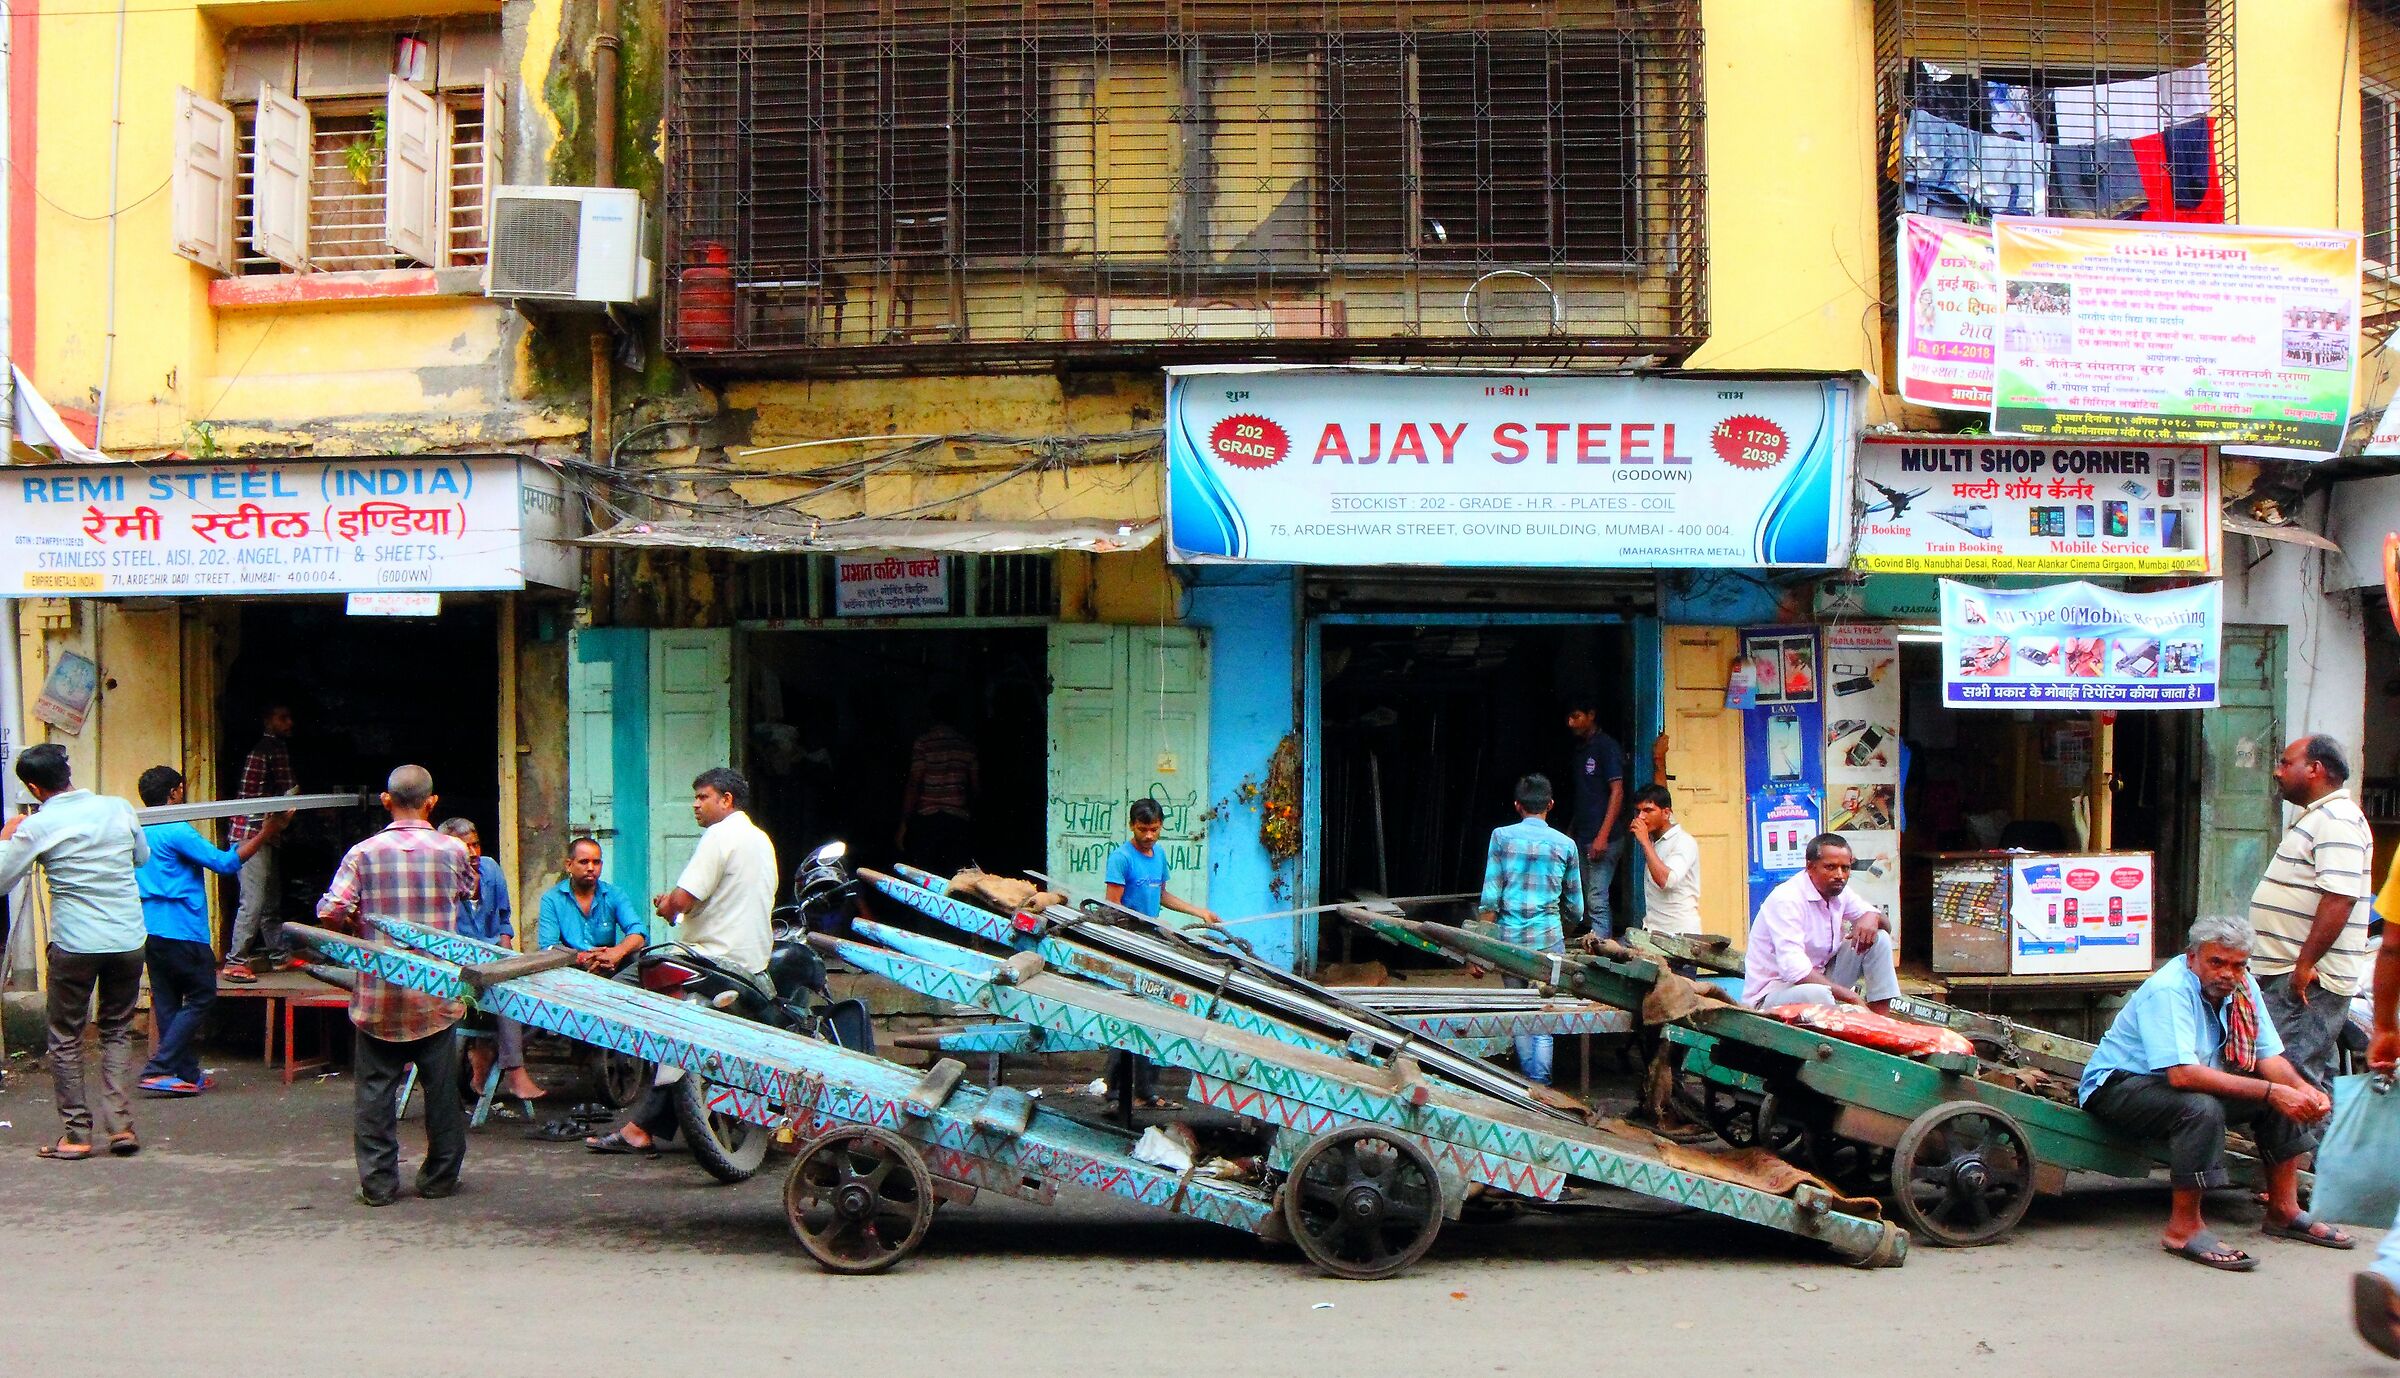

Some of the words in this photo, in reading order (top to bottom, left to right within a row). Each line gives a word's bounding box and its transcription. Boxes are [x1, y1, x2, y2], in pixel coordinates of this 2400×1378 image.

[1932, 343, 1991, 359] 01-4-2018
[1226, 390, 1250, 403] शुभ
[1499, 384, 1514, 397] श्री
[1717, 390, 1744, 400] लाभ
[2055, 413, 2083, 424] बुधवार
[1236, 423, 1264, 440] 202
[1717, 422, 1733, 438] H.
[1746, 428, 1781, 447] 1739
[1218, 438, 1276, 460] GRADE
[1312, 422, 1469, 465] AJAY
[1489, 422, 1693, 465] STEEL
[1741, 446, 1778, 465] 2039
[1901, 448, 1973, 473] MULTI
[1980, 448, 2047, 473] SHOP
[2052, 450, 2151, 475] CORNER
[23, 475, 124, 503] REMI
[149, 471, 299, 501] STEEL
[321, 460, 473, 502] (INDIA)
[1612, 469, 1693, 483] (GODOWN)
[1952, 477, 2001, 500] मल्टी
[2004, 476, 2044, 500] शॉप
[1331, 497, 1407, 510] STOCKIST
[1419, 497, 1445, 509] 202
[1459, 497, 1513, 510] GRADE
[1571, 497, 1628, 510] PLATES
[1641, 497, 1676, 510] COIL
[82, 504, 164, 544] रेमी
[192, 503, 311, 544] स्टील
[323, 501, 467, 542] (इण्डिया)
[1270, 524, 1291, 538] 75,
[1294, 523, 1392, 536] ARDESHWAR
[1396, 523, 1458, 538] STREET,
[1463, 523, 1521, 536] GOVIND
[1526, 524, 1601, 538] BUILDING,
[1605, 524, 1664, 536] MUMBAI
[1677, 525, 1702, 536] 400
[1706, 525, 1735, 537] 004.
[1871, 524, 1912, 538] Booking
[1619, 547, 1705, 557] (MAHARASHTRA
[1707, 547, 1746, 558] METAL)
[1925, 542, 1956, 553] Train
[1959, 542, 2004, 555] Booking
[2050, 540, 2098, 554] Mobile
[2101, 540, 2150, 554] Service
[39, 551, 106, 568] STAINLESS
[293, 546, 339, 563] PATTI
[354, 545, 365, 562] &
[374, 544, 444, 563] SHEETS.
[1874, 558, 1904, 569] Govind
[1905, 558, 1922, 571] Blg.
[1924, 558, 1964, 569] Nanubhai
[1965, 558, 1990, 570] Desai,
[1991, 558, 2015, 570] Road,
[2017, 558, 2035, 569] Near
[2037, 558, 2069, 569] Alankar
[2070, 558, 2101, 569] Cinema
[2102, 559, 2137, 571] Girgaon,
[2138, 559, 2170, 570] Mumbai
[2171, 560, 2185, 570] 400
[172, 572, 189, 584] DADI
[377, 567, 433, 586] (GODOWN)
[841, 563, 873, 582] प्रभात
[1891, 605, 1940, 614] RAJASTHA
[1994, 609, 2014, 623] All
[2019, 609, 2056, 628] Type
[2060, 606, 2076, 623] Of
[2077, 607, 2131, 624] Mobile
[2134, 608, 2206, 628] Repairing
[1962, 683, 1992, 699] सभी
[1993, 684, 2028, 699] प्रकार
[2029, 683, 2042, 698] के
[2082, 683, 2128, 699] रिपेरिंग
[2129, 684, 2159, 699] कीया
[2161, 684, 2186, 699] जाता
[1771, 704, 1796, 714] LAVA
[1890, 998, 1911, 1013] 0841
